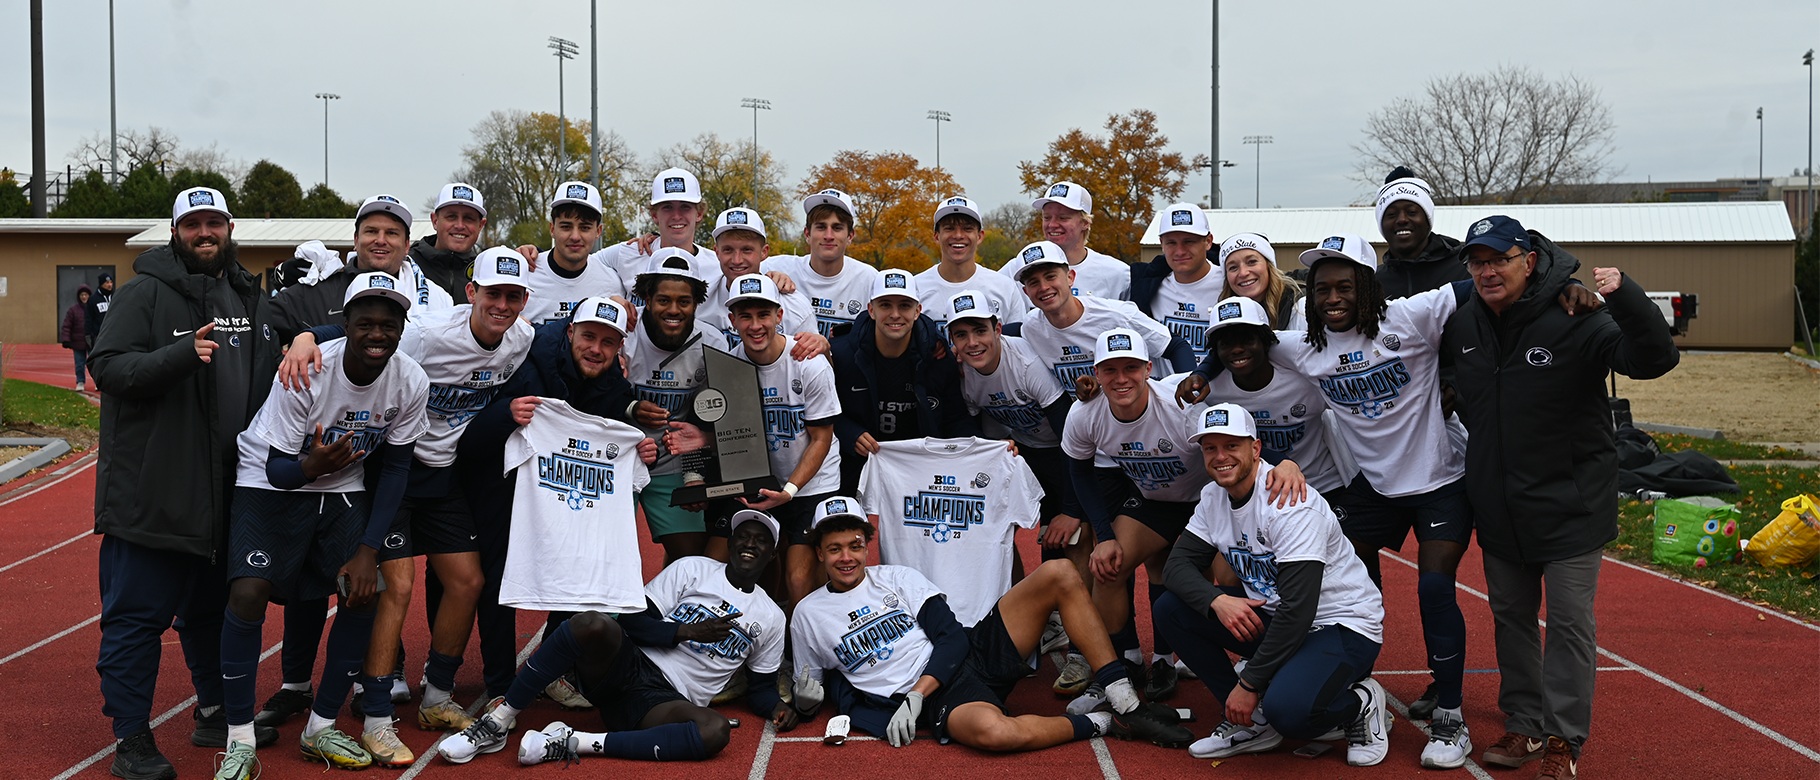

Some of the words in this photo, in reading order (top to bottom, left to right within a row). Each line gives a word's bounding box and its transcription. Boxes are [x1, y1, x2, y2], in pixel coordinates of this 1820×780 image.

[1235, 239, 1257, 249] State
[1335, 363, 1351, 373] MEN'S
[1352, 360, 1370, 371] SOCCER
[1318, 361, 1411, 402] CHAMPIONS
[763, 387, 778, 397] 1G
[1384, 401, 1394, 409] 23
[336, 420, 353, 428] MEN'S
[767, 410, 806, 434] PIONS
[880, 413, 896, 434] 8
[718, 433, 758, 442] CONFERENCE
[1259, 425, 1306, 449] PIONS
[562, 448, 575, 456] MEN'S
[576, 450, 594, 459] SOCCER
[538, 455, 614, 494] CHAMPIONS
[586, 500, 594, 508] 23
[903, 496, 986, 525] CHAMPIONS
[924, 529, 930, 537] 20
[953, 531, 961, 539] 23
[848, 620, 862, 630] MEN'S
[862, 611, 879, 623] SOCCER
[833, 613, 915, 668] CHAMPIONS
[868, 658, 877, 668] 20
